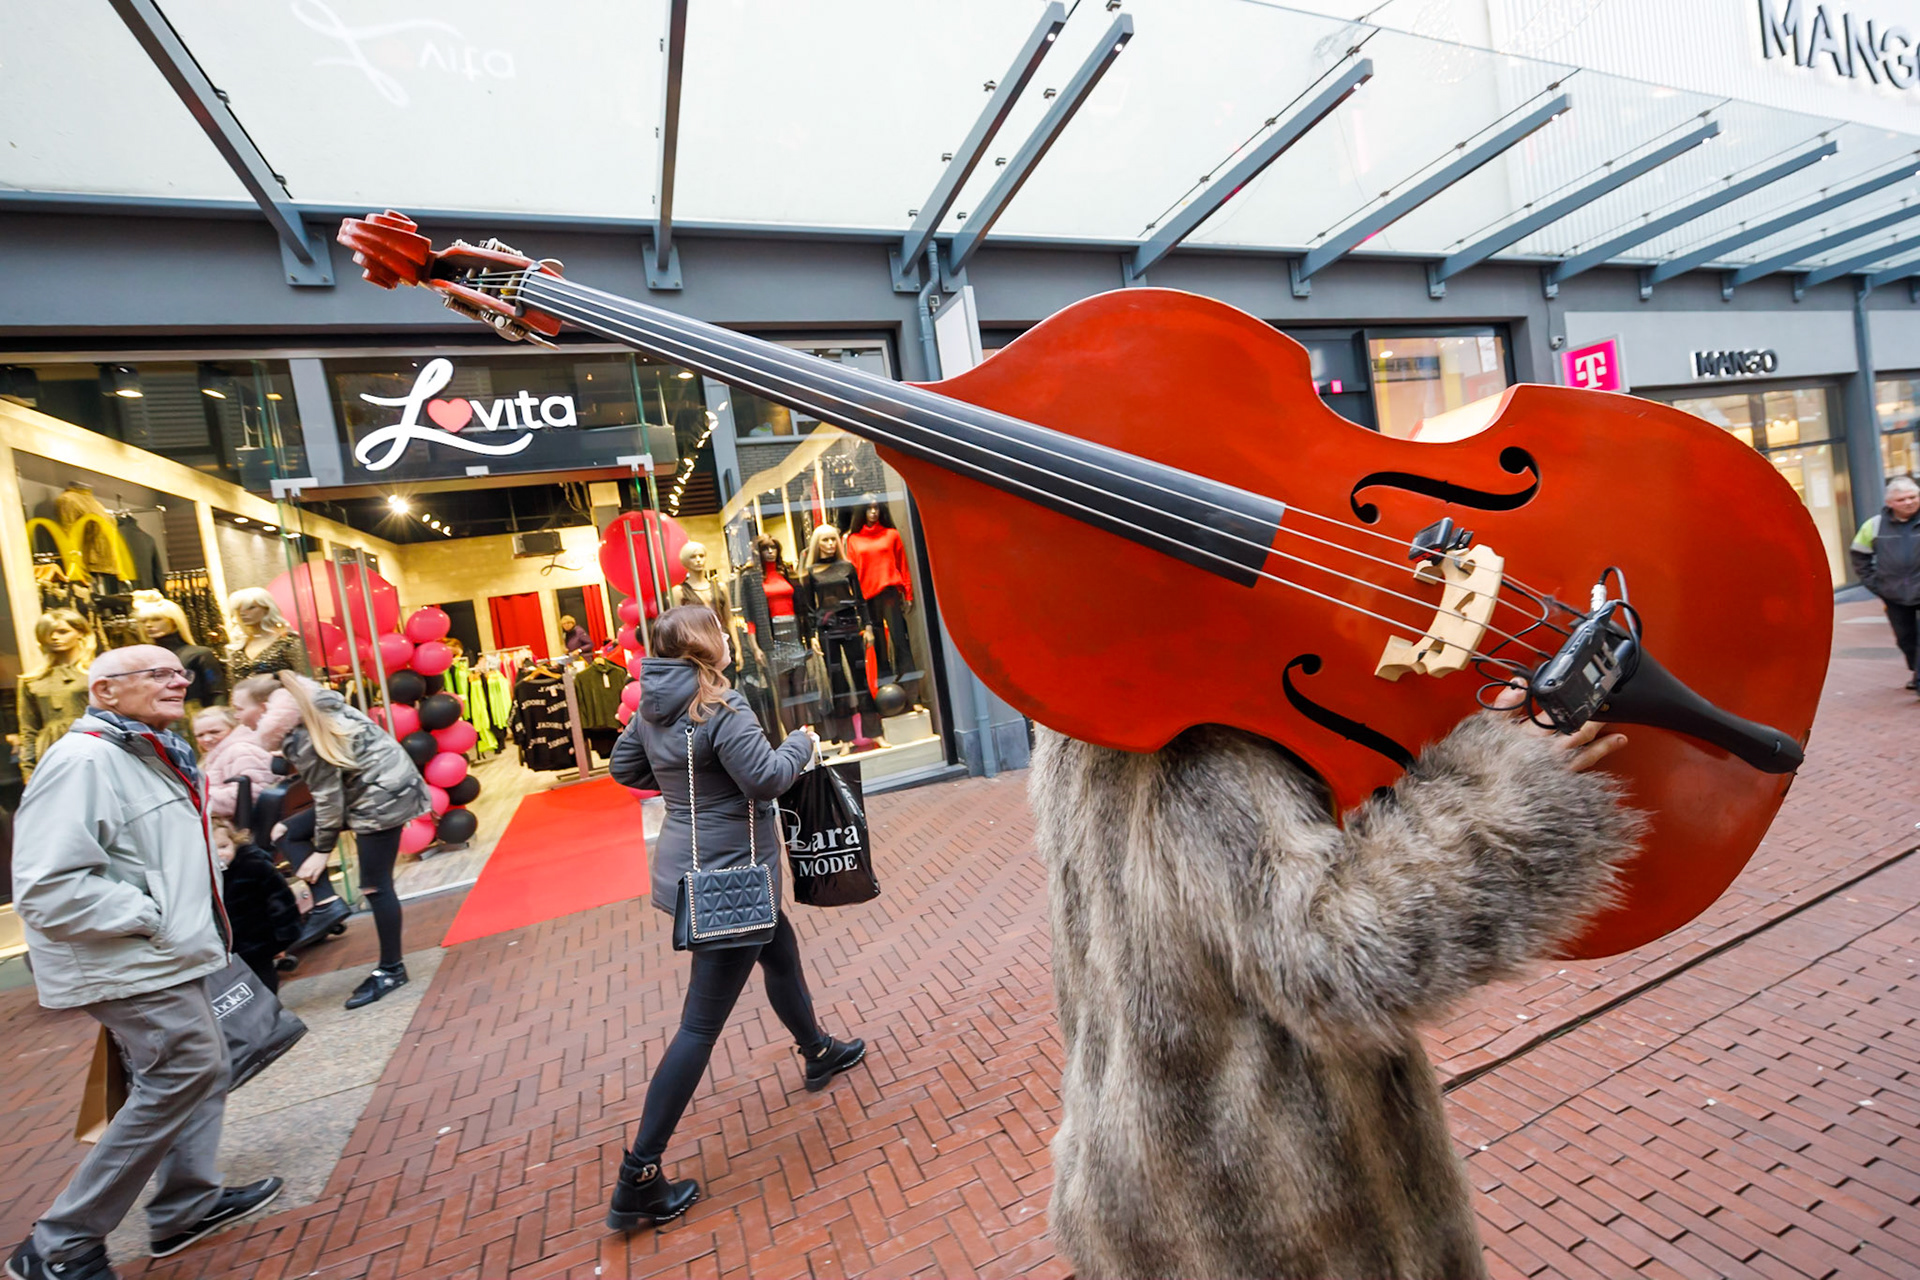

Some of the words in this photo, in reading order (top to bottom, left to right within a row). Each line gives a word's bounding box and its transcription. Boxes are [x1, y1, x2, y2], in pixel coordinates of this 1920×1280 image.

[1758, 0, 1920, 90] MANG
[1690, 348, 1778, 379] MANGO
[788, 826, 859, 852] Lara
[799, 855, 858, 877] MODE
